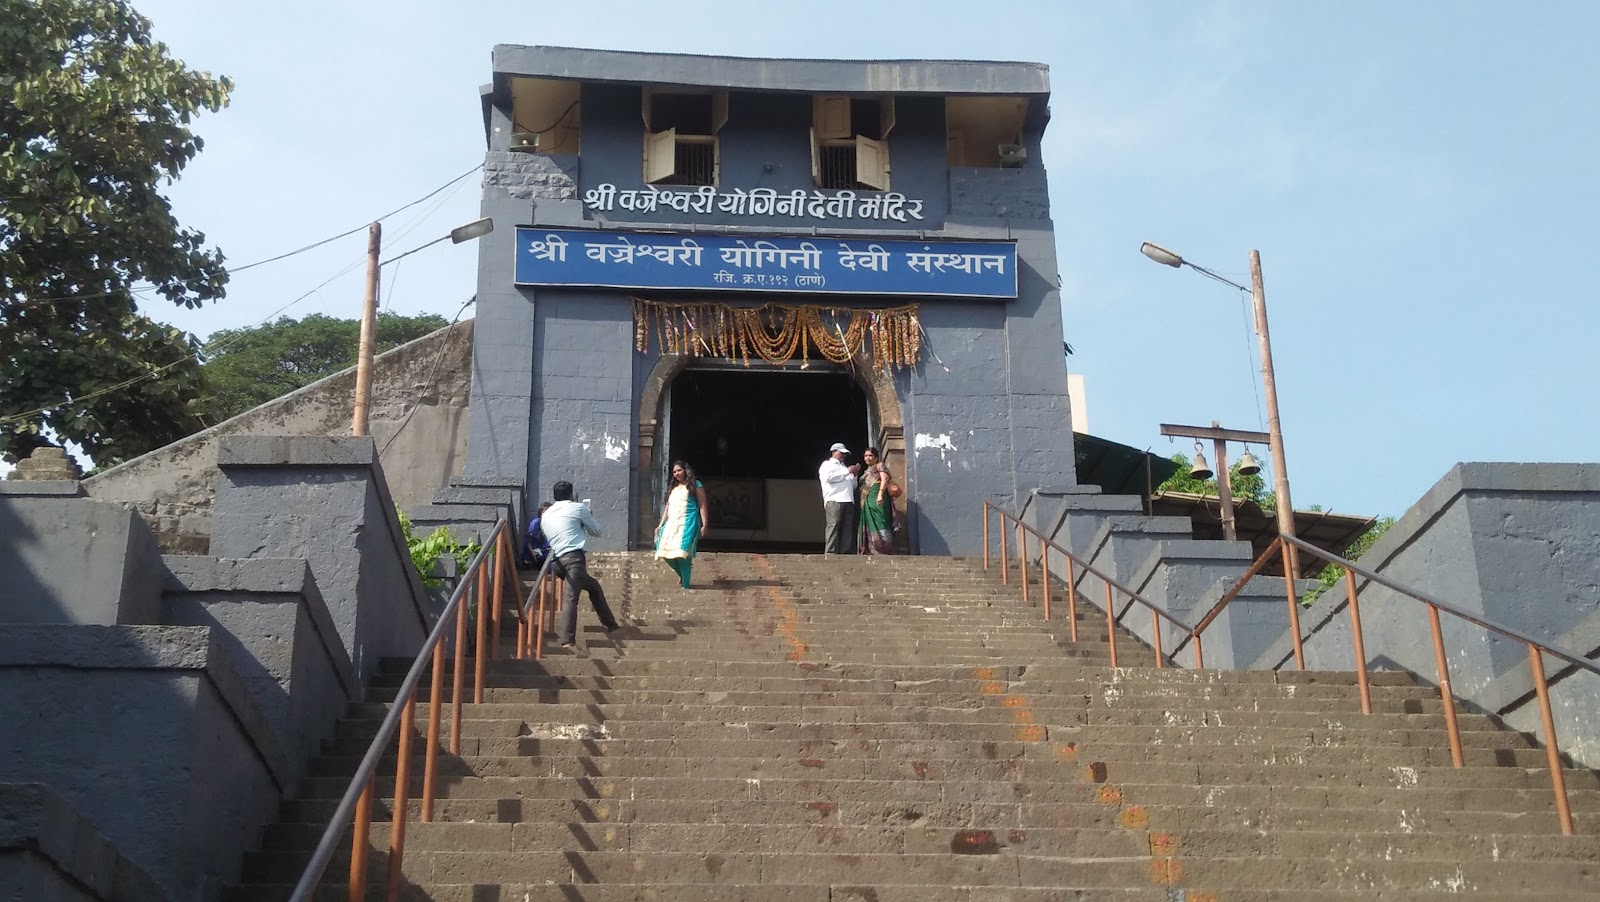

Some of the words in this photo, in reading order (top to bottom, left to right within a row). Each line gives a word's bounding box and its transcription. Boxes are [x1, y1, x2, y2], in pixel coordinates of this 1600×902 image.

[583, 183, 616, 212] श्री
[619, 184, 717, 215] वज्रेश्वरी
[718, 187, 807, 217] योगिनी
[807, 190, 857, 219] देवी
[858, 192, 924, 222] मंदिर
[528, 234, 568, 262] श्री
[584, 236, 704, 266] वज्रेश्वरी
[719, 239, 822, 270] योगिनी
[838, 243, 891, 272] देवी
[906, 245, 1006, 275] संस्थान
[713, 270, 737, 284] रजि.
[795, 272, 826, 287] (ठाणे)
